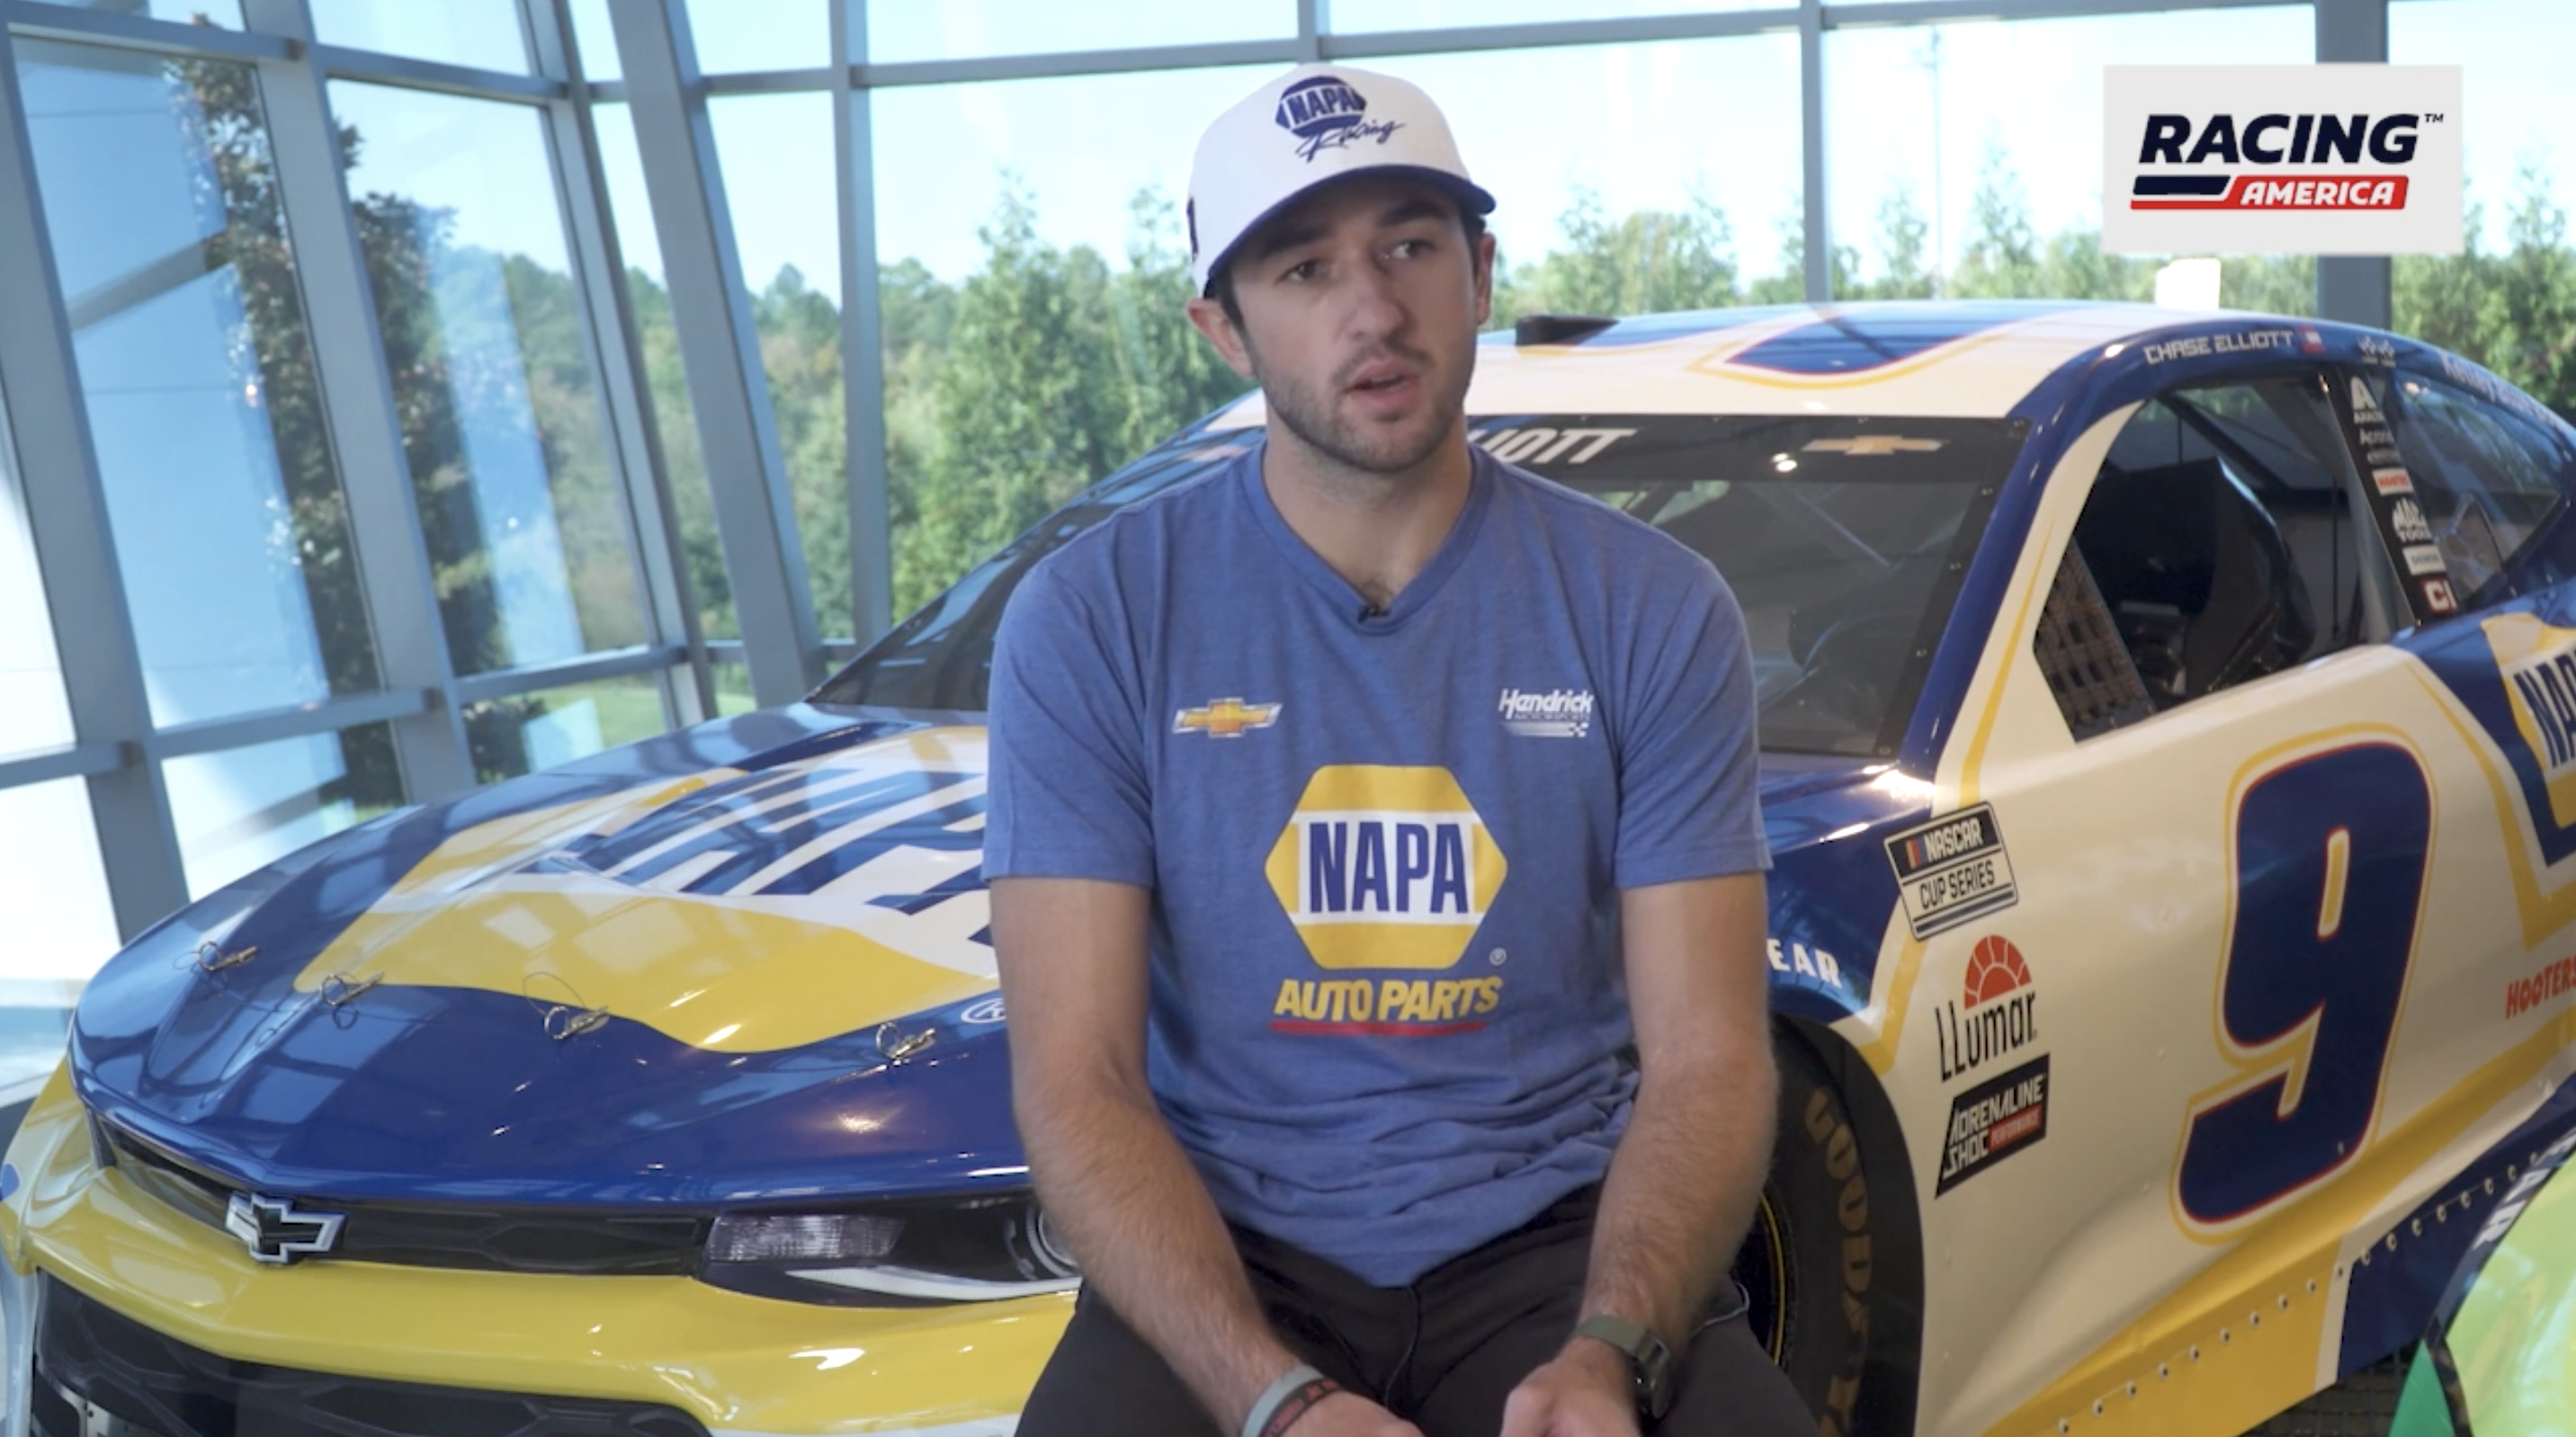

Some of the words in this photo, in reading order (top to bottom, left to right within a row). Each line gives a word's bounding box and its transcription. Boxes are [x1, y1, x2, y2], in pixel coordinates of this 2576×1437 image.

[1285, 85, 1358, 126] NAPA
[1295, 118, 1406, 164] Racing
[2143, 335, 2213, 365] CHASE
[2214, 329, 2294, 353] ELLIOTT
[1498, 688, 1594, 719] Hendrick
[1922, 817, 1983, 863] NASCAR
[1308, 821, 1470, 915] NAPA
[1919, 878, 1946, 910] CUP
[1948, 860, 1996, 900] SERIES
[1273, 977, 1375, 1022] AUTO
[1377, 976, 1504, 1022] PARTS
[2178, 741, 2432, 1225] 9
[1949, 1074, 2044, 1147] ADRENALINE
[1942, 1129, 1989, 1181] SHOC
